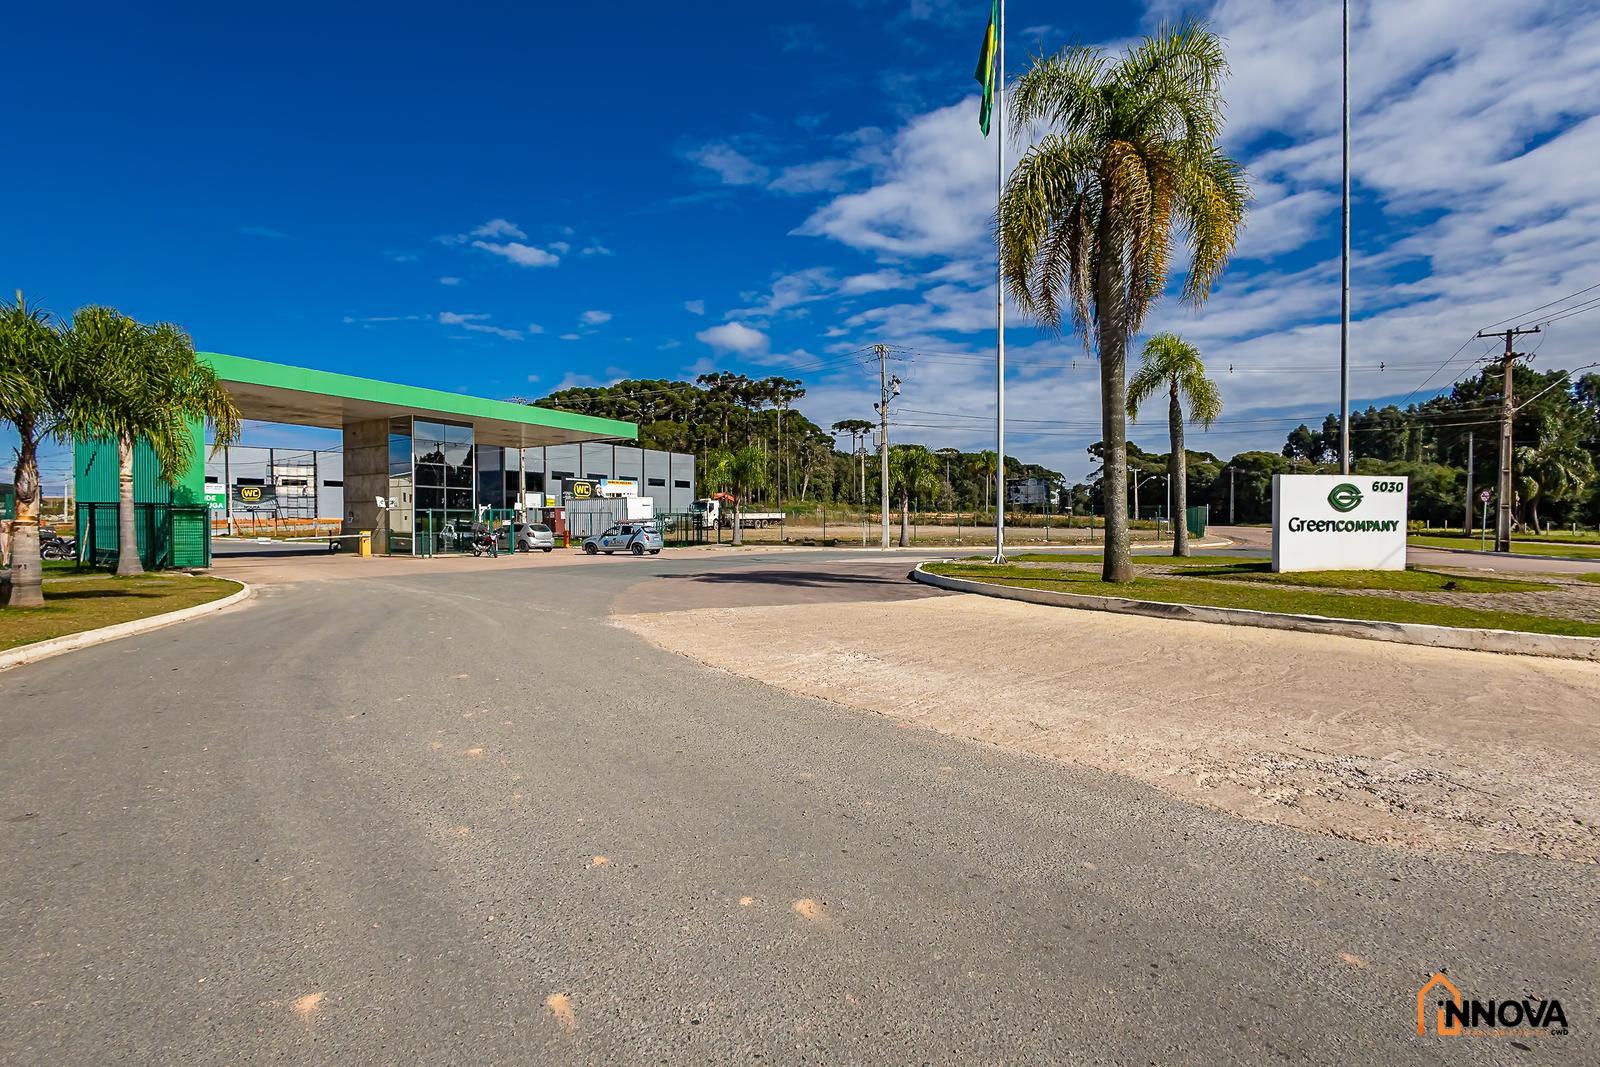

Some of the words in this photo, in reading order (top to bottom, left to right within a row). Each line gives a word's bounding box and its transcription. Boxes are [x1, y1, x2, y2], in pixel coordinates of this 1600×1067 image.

[576, 485, 590, 494] WC
[1371, 481, 1404, 492] 6030
[244, 489, 259, 497] WC
